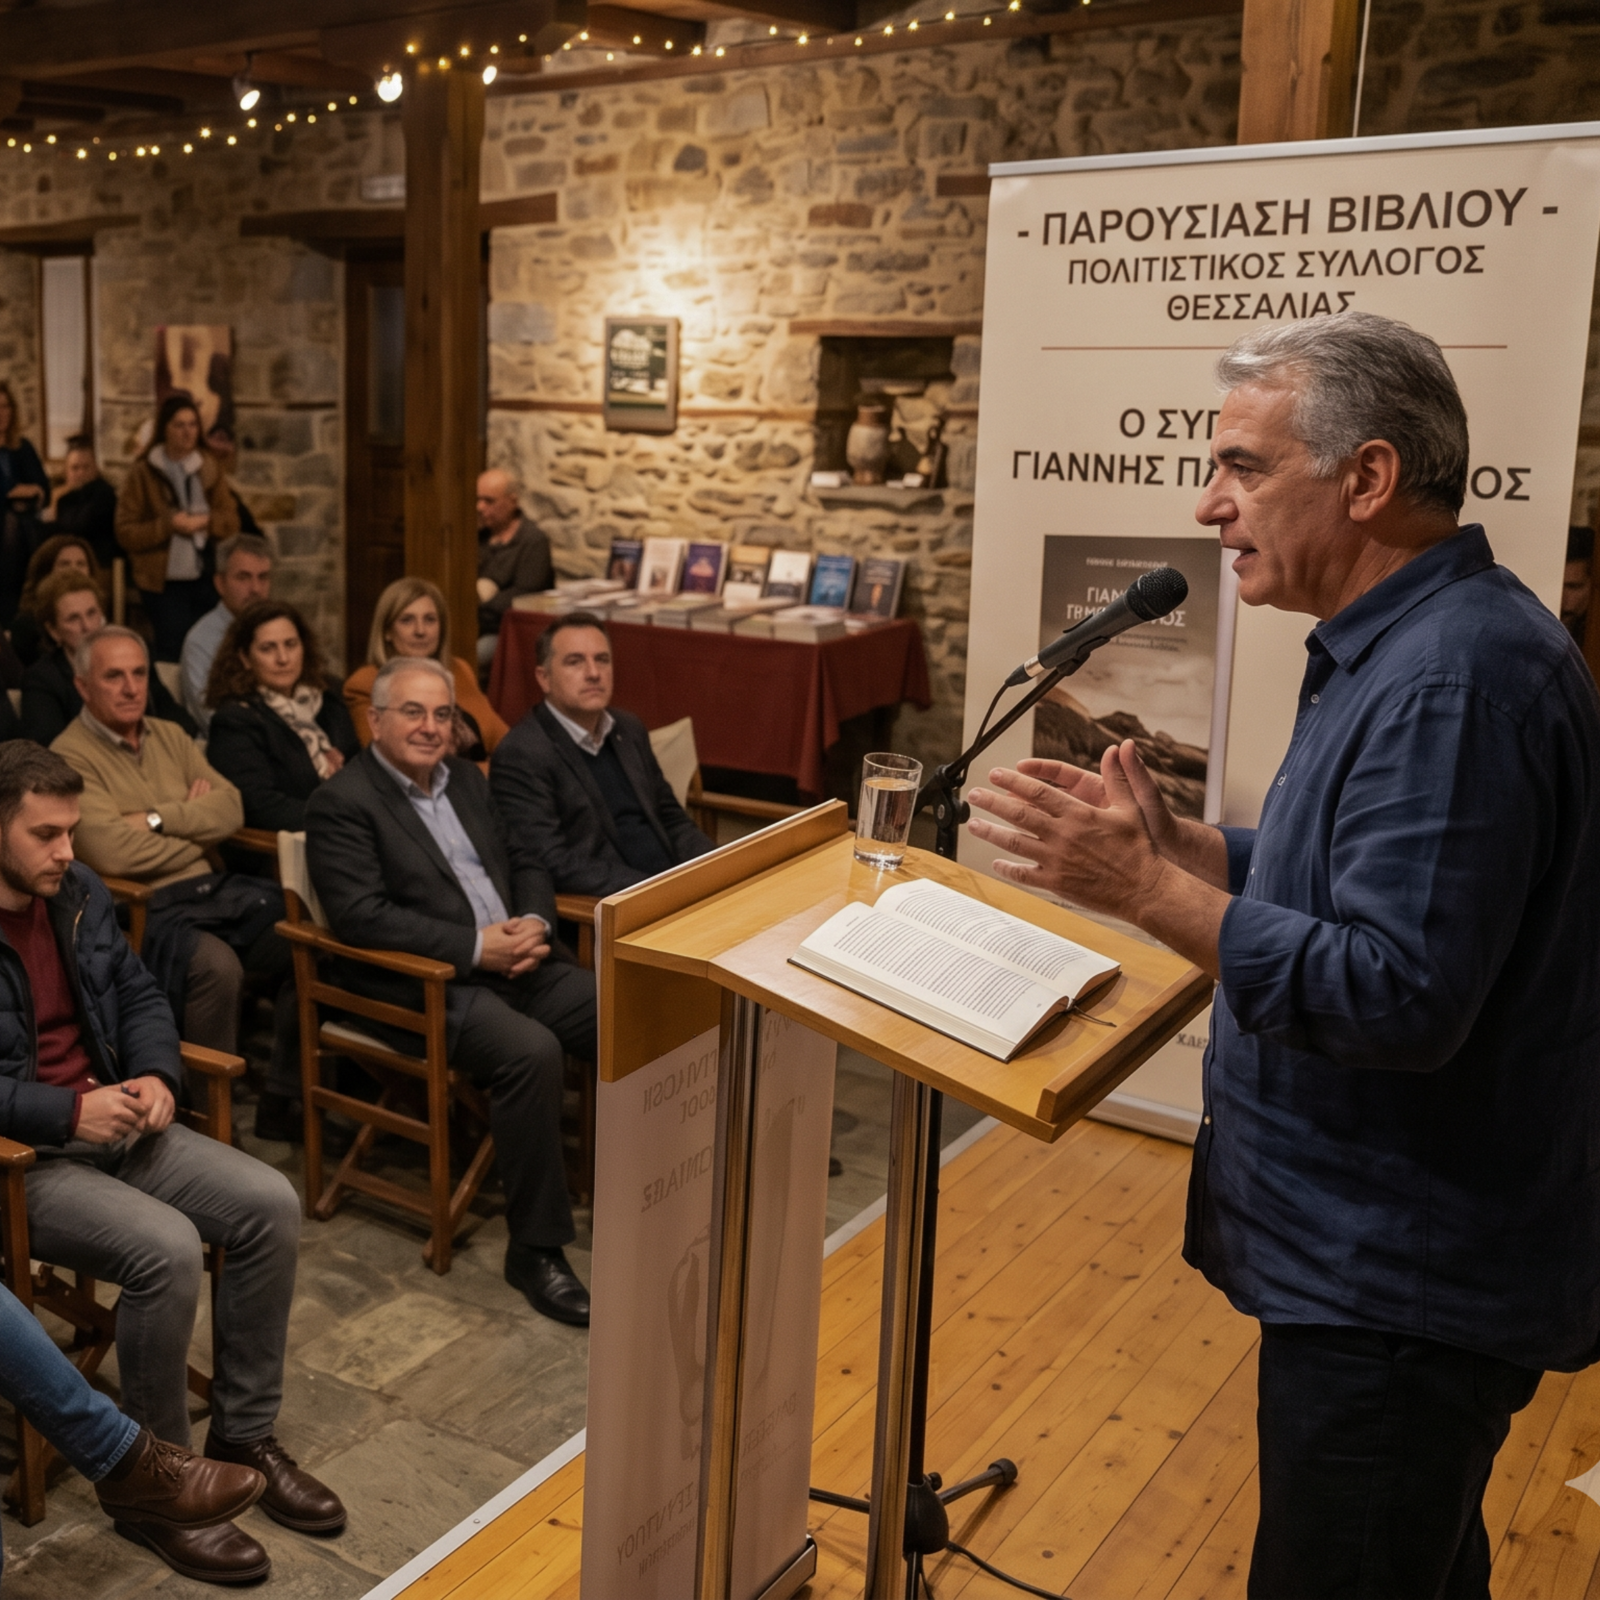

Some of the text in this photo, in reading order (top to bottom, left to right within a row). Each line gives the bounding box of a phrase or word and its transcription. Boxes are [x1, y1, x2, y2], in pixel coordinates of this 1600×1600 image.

[1042, 199, 1311, 246] ΠΑΡΟΥΣΙΑΣΗ
[1327, 186, 1529, 234] ΒΙΒΛΙΟΥ
[1068, 244, 1486, 285] ΠΟΛΙΤΙΣΤΙΚΟΣ ΣΥΛΛΟΓΟΣ
[1167, 290, 1356, 321] ΘΕΣΣΑΛΙΑΣ
[1119, 408, 1146, 439] Ο
[1012, 450, 1165, 486] ΓΙΑΝΝΗΣ
[1470, 465, 1532, 502] ΟΣ
